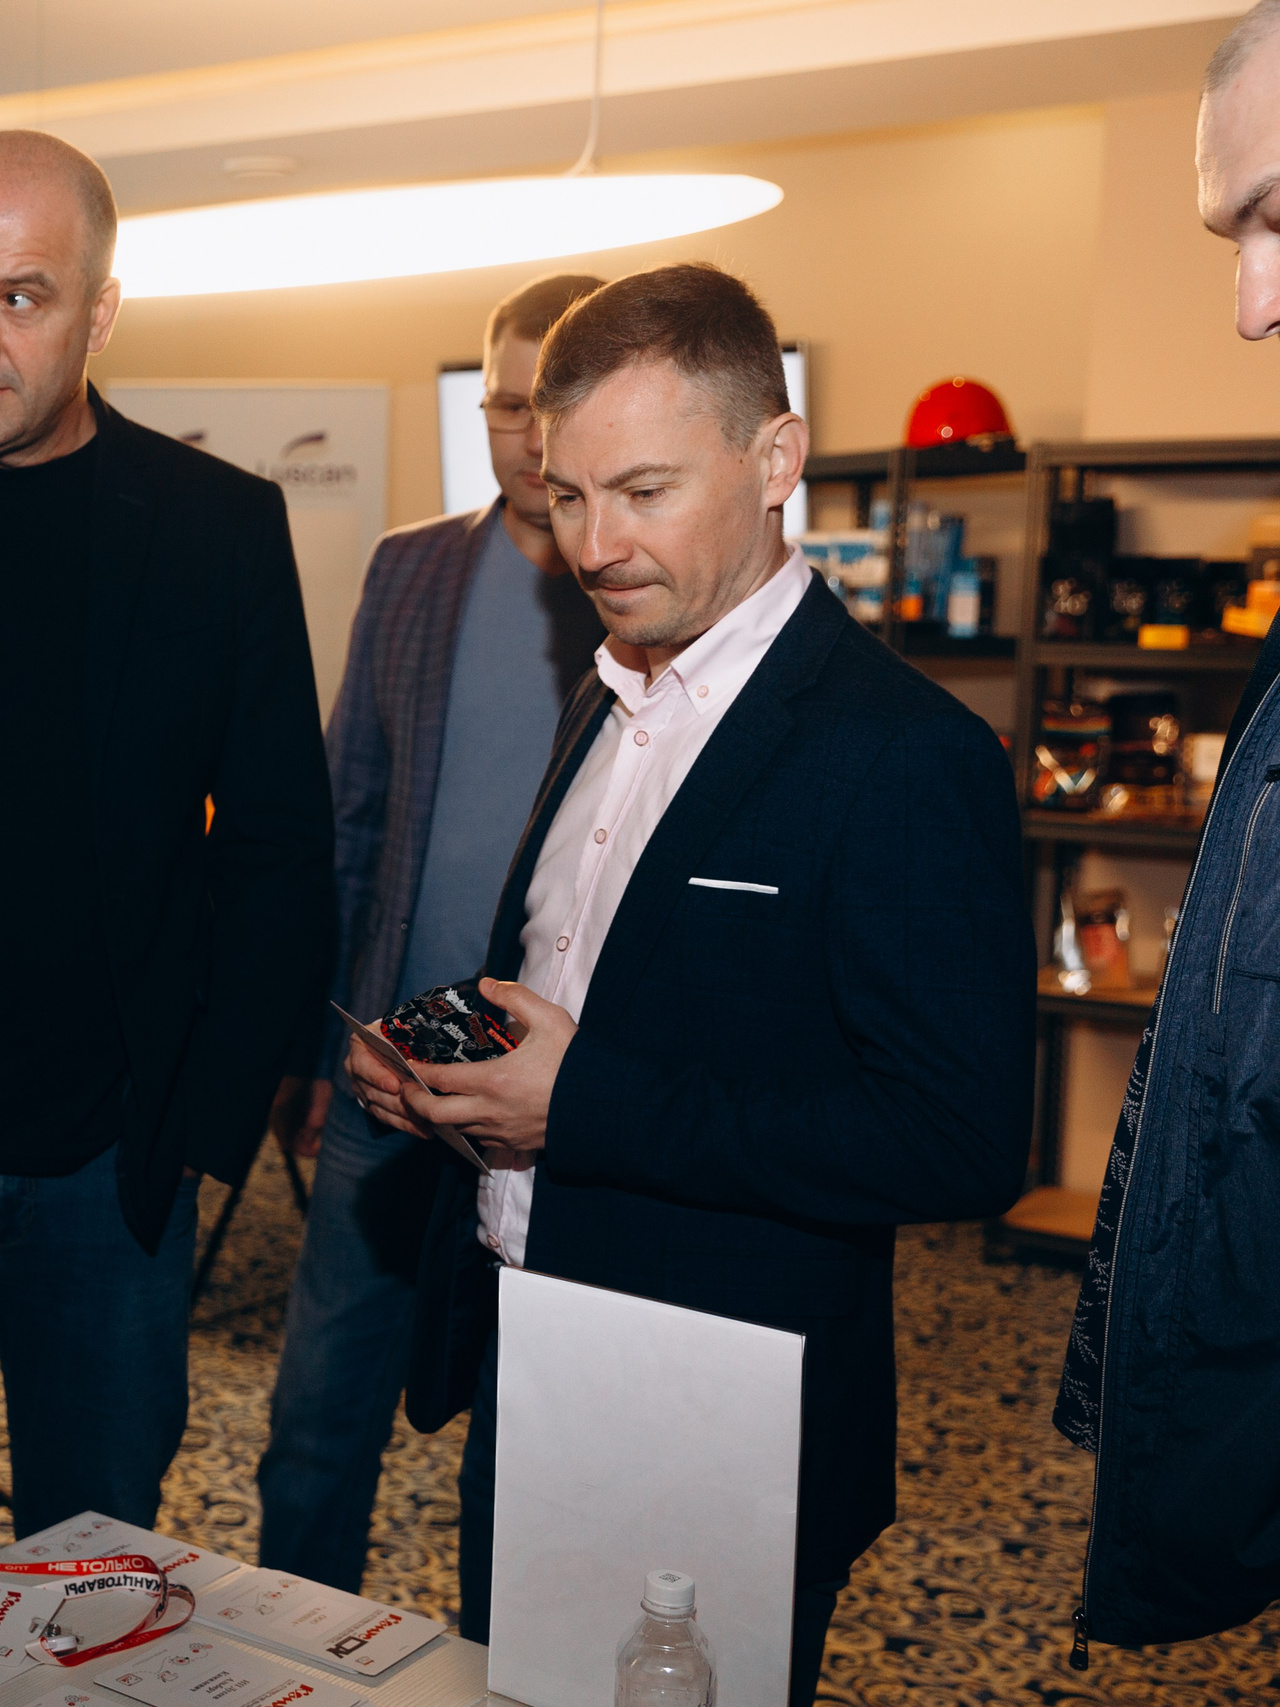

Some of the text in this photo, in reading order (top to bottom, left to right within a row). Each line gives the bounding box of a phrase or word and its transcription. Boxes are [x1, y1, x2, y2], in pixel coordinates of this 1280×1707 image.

[47, 1562, 78, 1572] НЕ
[81, 1556, 145, 1573] ТОЛЬКО
[64, 1574, 161, 1596] КАНЦТОВАРЫ
[358, 1613, 402, 1640] Комус
